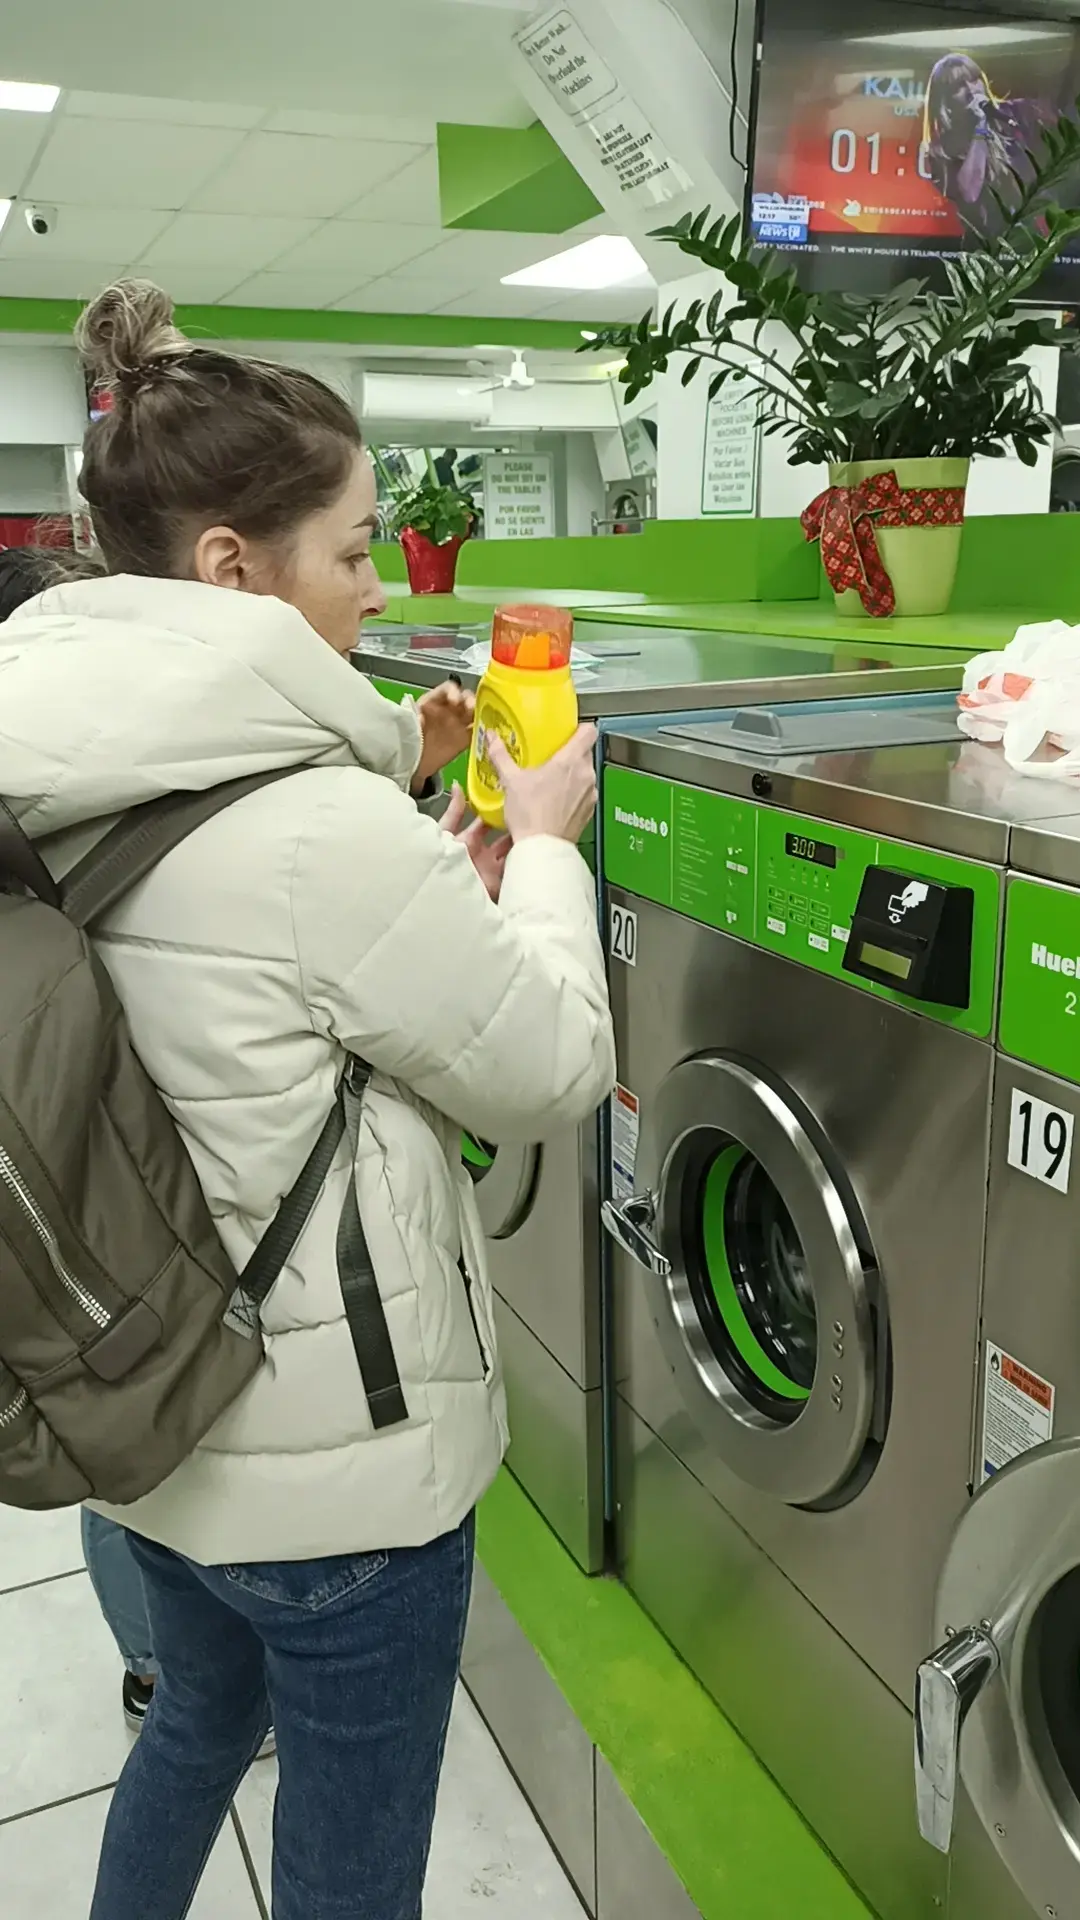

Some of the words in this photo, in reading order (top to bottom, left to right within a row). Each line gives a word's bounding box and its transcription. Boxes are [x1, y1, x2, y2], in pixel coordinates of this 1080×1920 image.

[831, 245, 845, 254] THE
[847, 247, 873, 255] WHITE
[874, 248, 900, 256] HOUSE
[504, 462, 533, 471] PLEASE
[615, 806, 658, 834] Huebsch
[792, 836, 816, 859] 3.00
[612, 910, 635, 960] 20
[1064, 991, 1077, 1016] 2
[1019, 1100, 1067, 1180] 19
